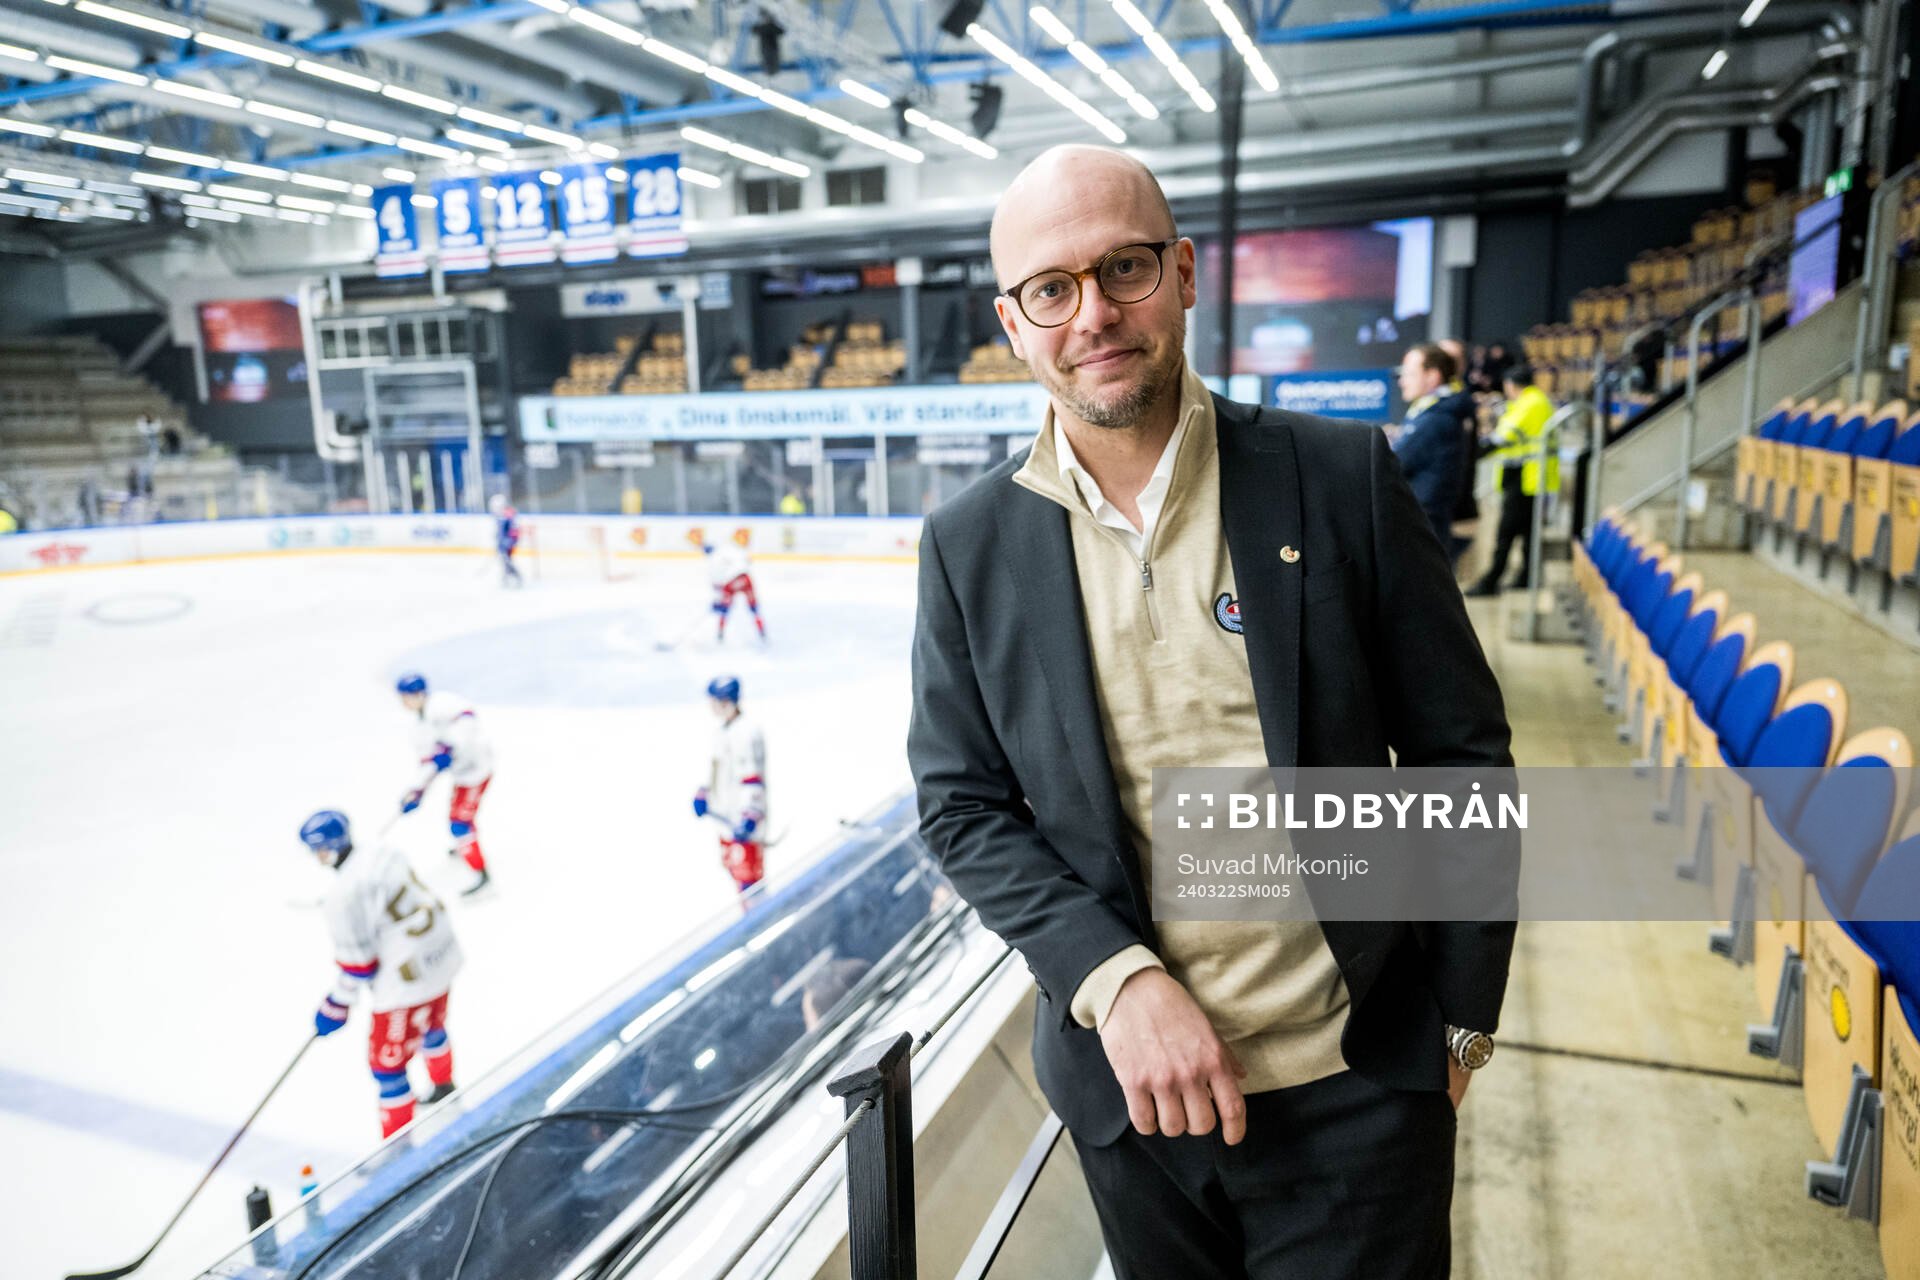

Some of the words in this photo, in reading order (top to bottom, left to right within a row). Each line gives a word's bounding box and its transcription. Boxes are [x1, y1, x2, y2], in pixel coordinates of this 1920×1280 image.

[442, 188, 471, 235] 5
[496, 181, 545, 230] 12
[564, 175, 610, 224] 15
[632, 166, 680, 217] 28
[379, 194, 406, 240] 4
